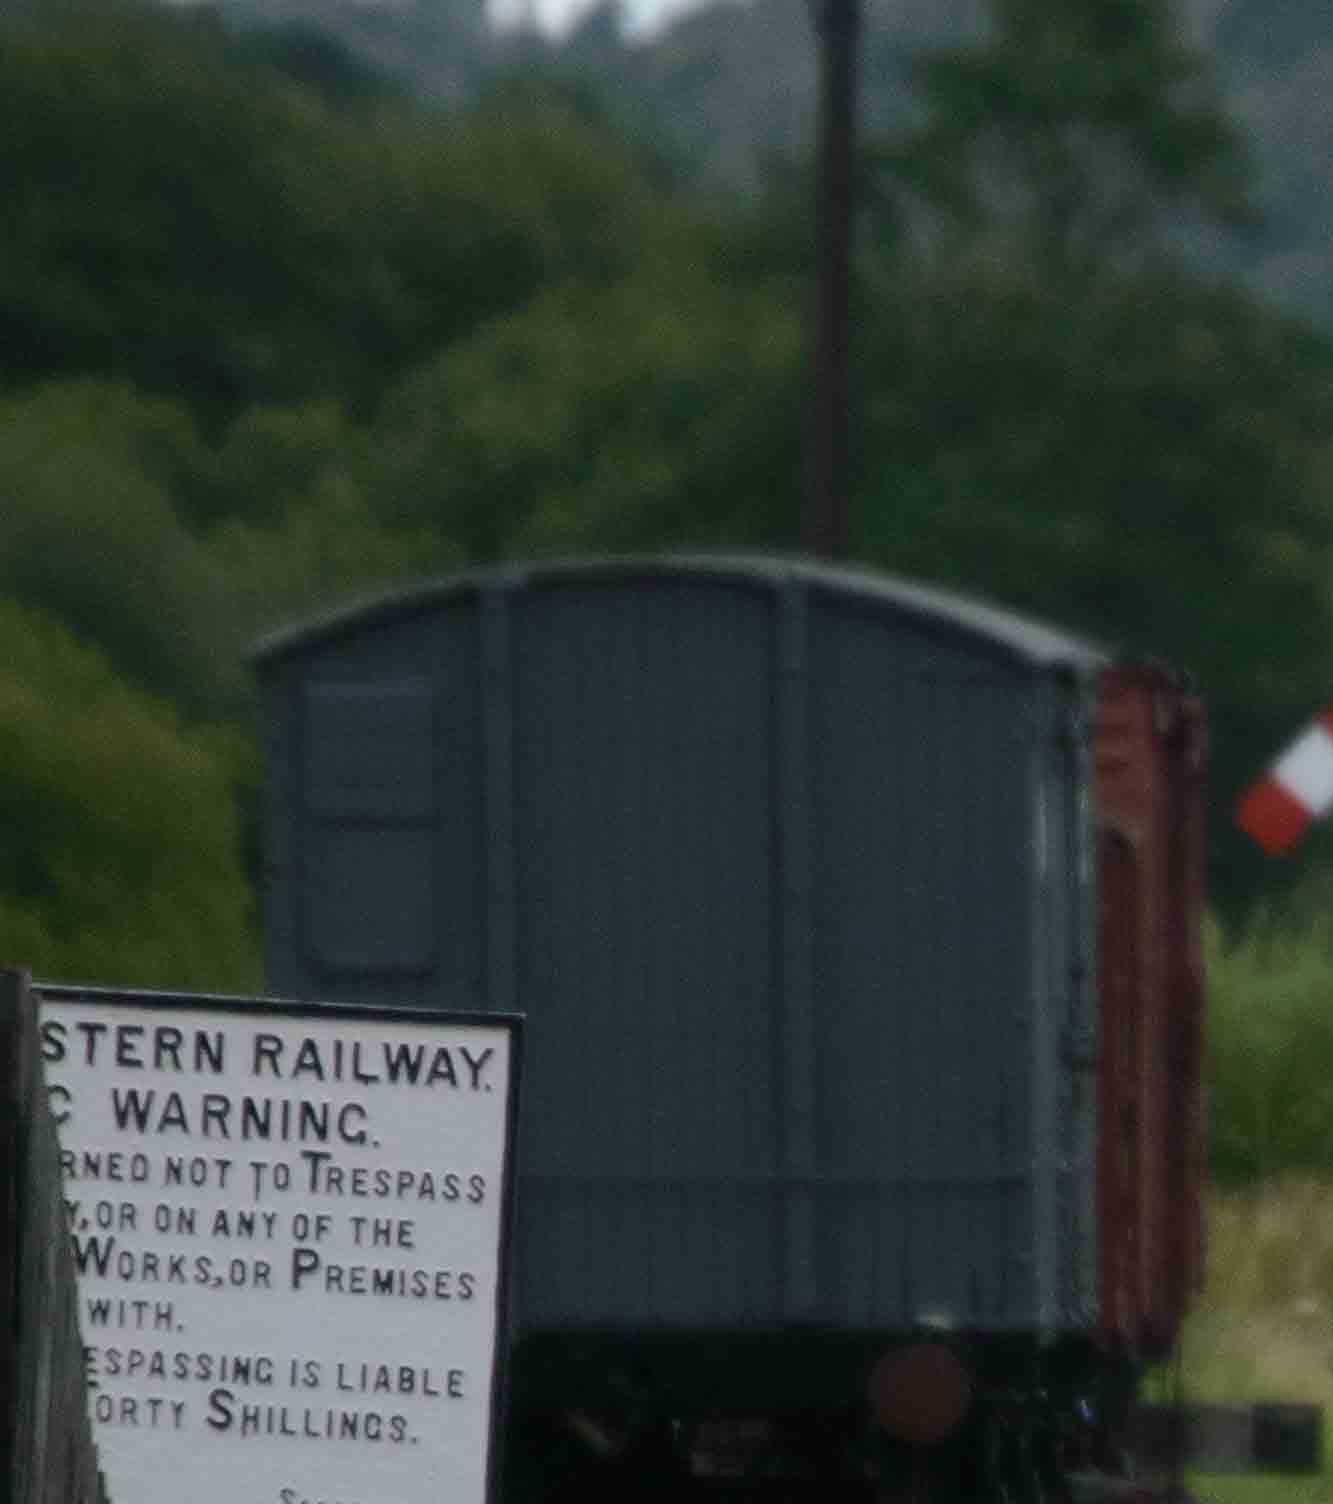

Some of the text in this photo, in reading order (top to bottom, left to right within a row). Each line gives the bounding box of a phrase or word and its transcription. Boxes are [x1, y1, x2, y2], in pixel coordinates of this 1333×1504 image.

[253, 1033, 495, 1092] RAILWAY.
[111, 1088, 380, 1146] WARNING.
[164, 1155, 231, 1188] NOT
[250, 1161, 290, 1200] TO
[301, 1150, 486, 1203] TRESPASS
[155, 1203, 195, 1235] ON
[212, 1209, 276, 1238] ANY
[292, 1213, 332, 1241] OF
[350, 1217, 415, 1248] THE
[292, 1248, 476, 1299] PREMISES
[87, 1299, 184, 1332] WITH.
[290, 1358, 321, 1388] IS
[337, 1363, 464, 1398] LIABLE
[88, 1382, 419, 1444] ORTY SHILLINGS.
